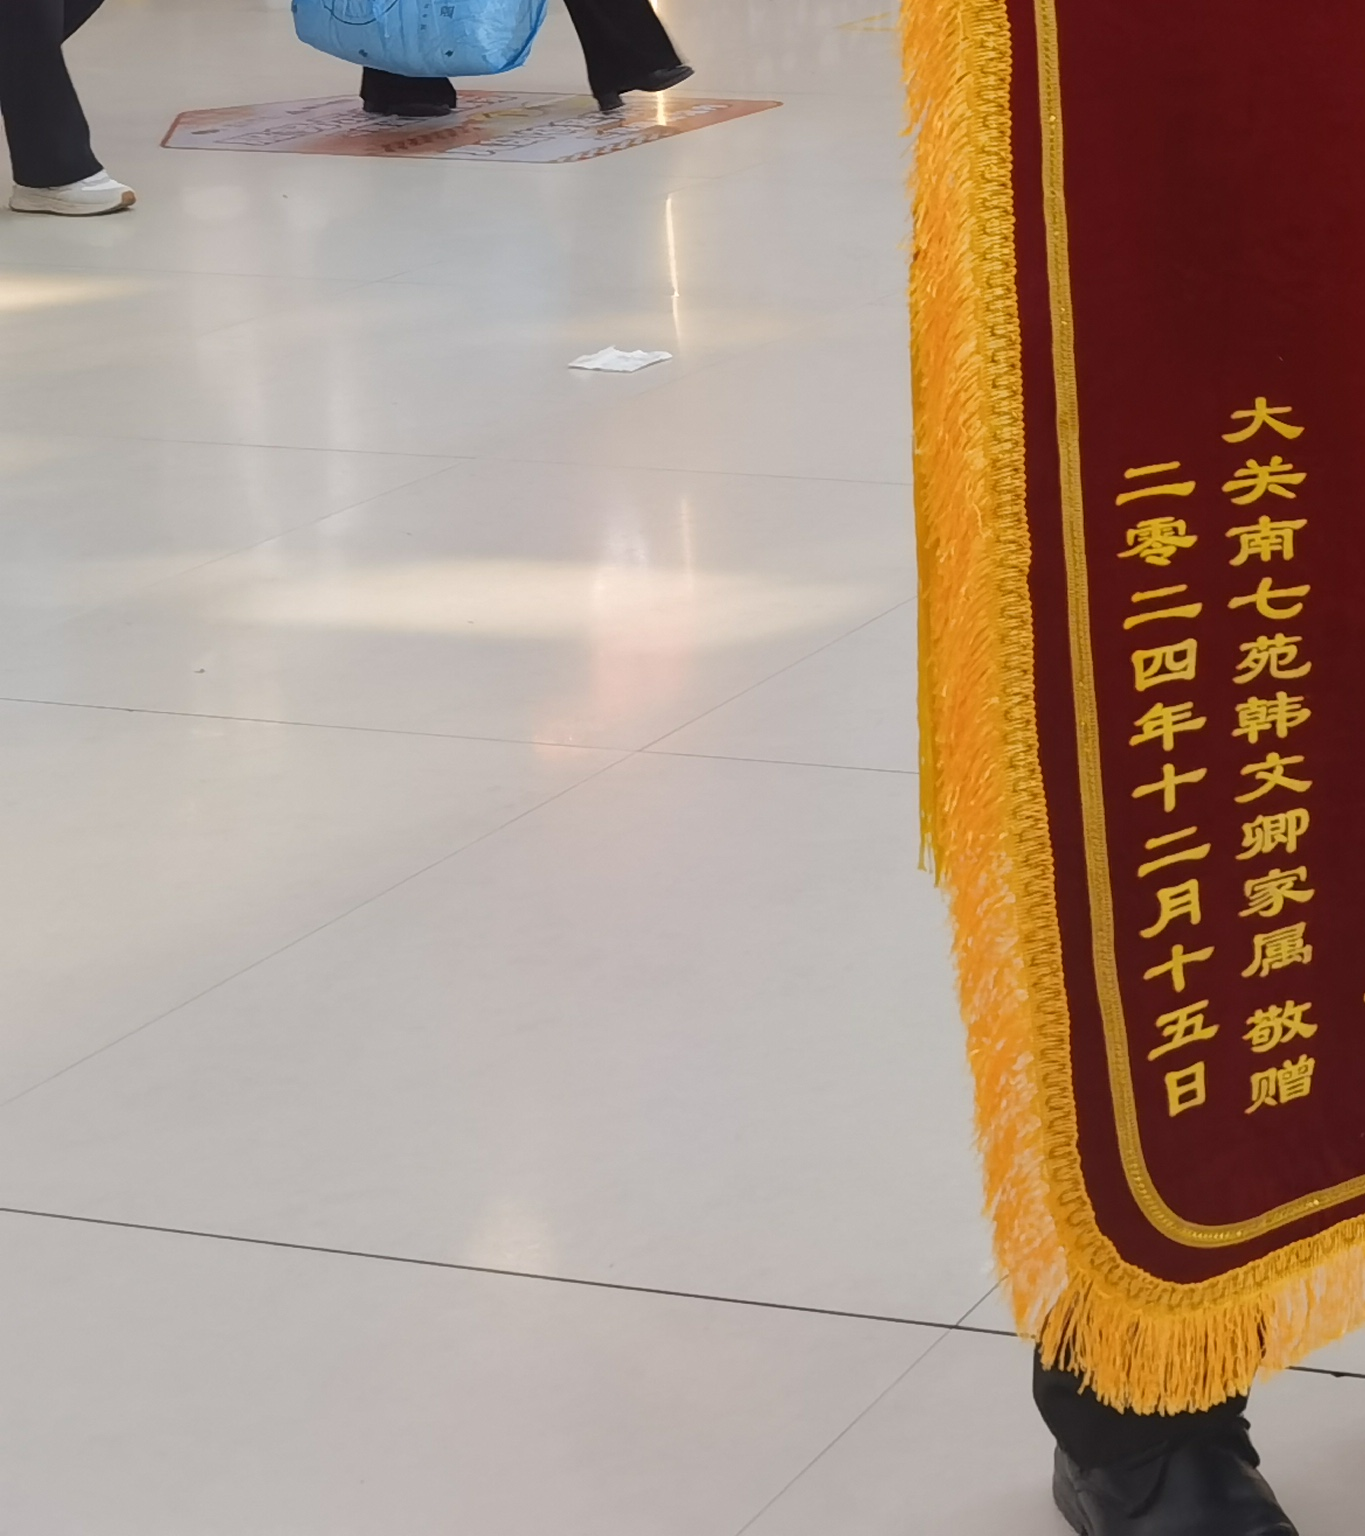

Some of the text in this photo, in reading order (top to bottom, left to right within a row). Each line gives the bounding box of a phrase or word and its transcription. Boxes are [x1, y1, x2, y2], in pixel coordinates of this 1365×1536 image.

[1114, 460, 1220, 1118] 二零二四年十二月十五日
